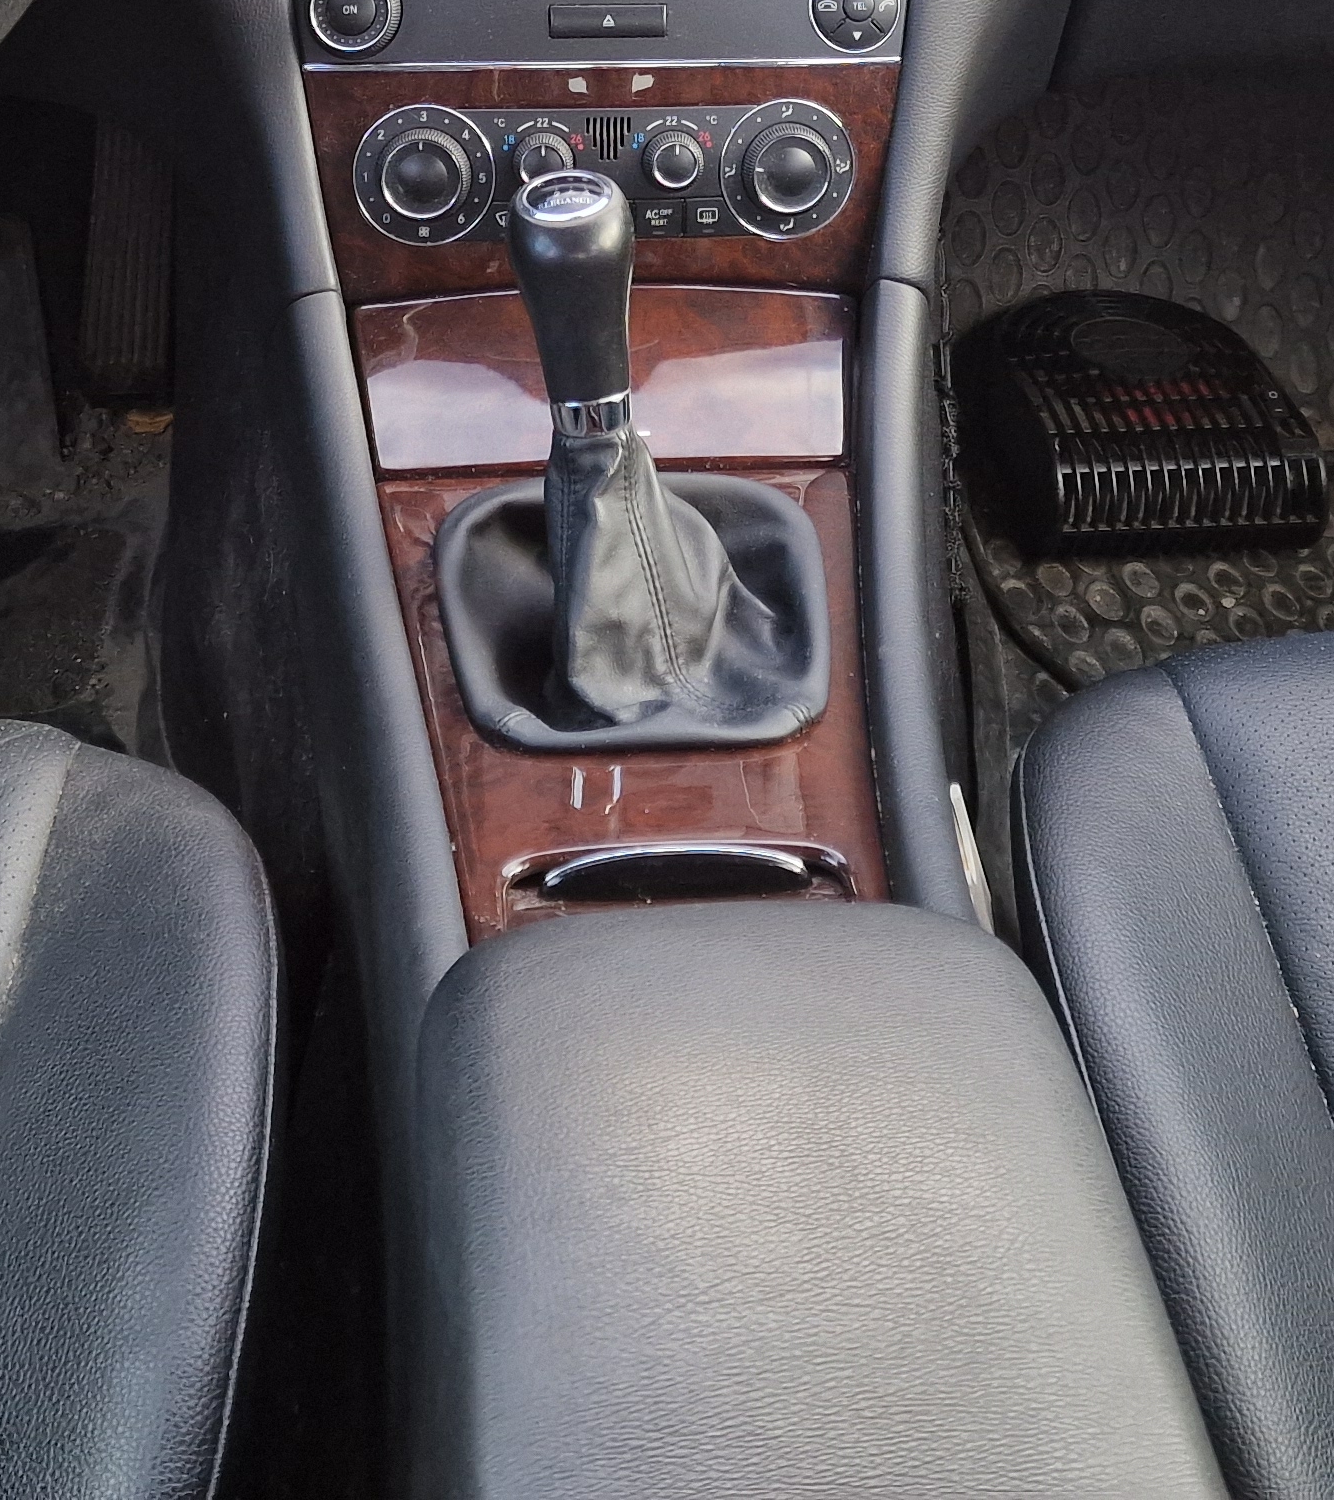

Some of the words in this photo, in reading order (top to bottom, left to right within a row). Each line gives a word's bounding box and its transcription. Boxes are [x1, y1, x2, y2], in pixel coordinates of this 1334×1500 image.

[342, 5, 358, 15] ON
[852, 2, 867, 11] TEL
[536, 118, 549, 128] 22
[665, 116, 678, 126] 22
[504, 134, 515, 145] 18
[570, 134, 583, 144] 26
[633, 133, 645, 143] 18
[698, 131, 711, 141] 26
